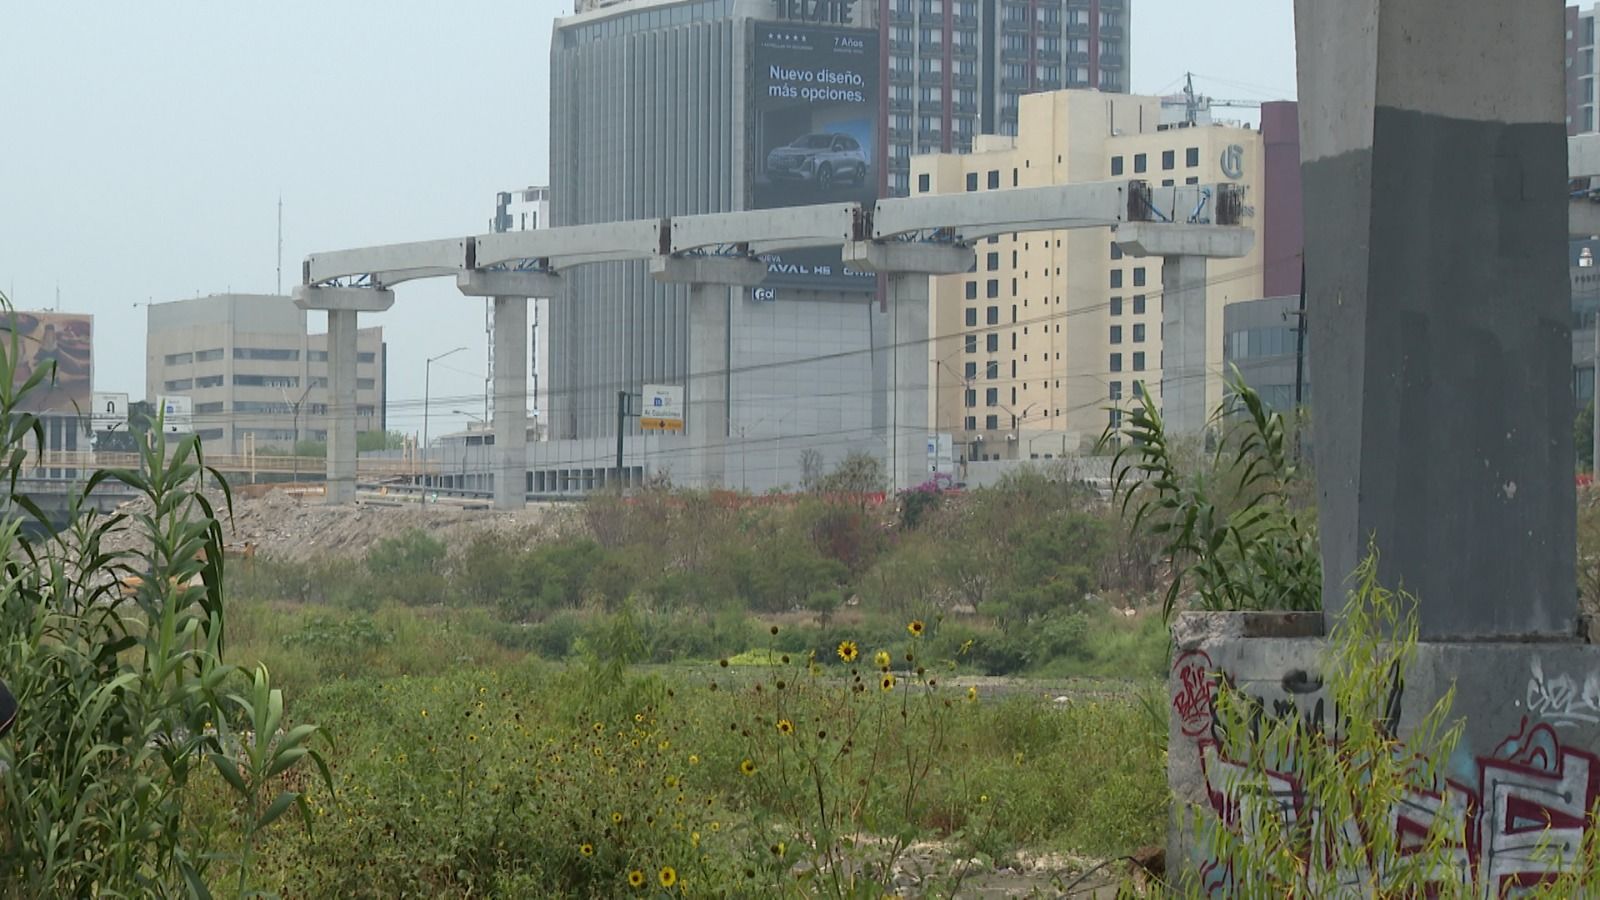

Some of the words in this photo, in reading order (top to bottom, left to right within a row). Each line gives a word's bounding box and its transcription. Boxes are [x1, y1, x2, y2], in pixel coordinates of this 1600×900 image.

[834, 37, 839, 47] 7
[841, 37, 864, 48] Años
[769, 65, 813, 82] Nuevo
[816, 68, 865, 88] diseño,
[768, 83, 798, 98] más
[801, 86, 866, 102] opciones.
[767, 264, 809, 274] AVAL
